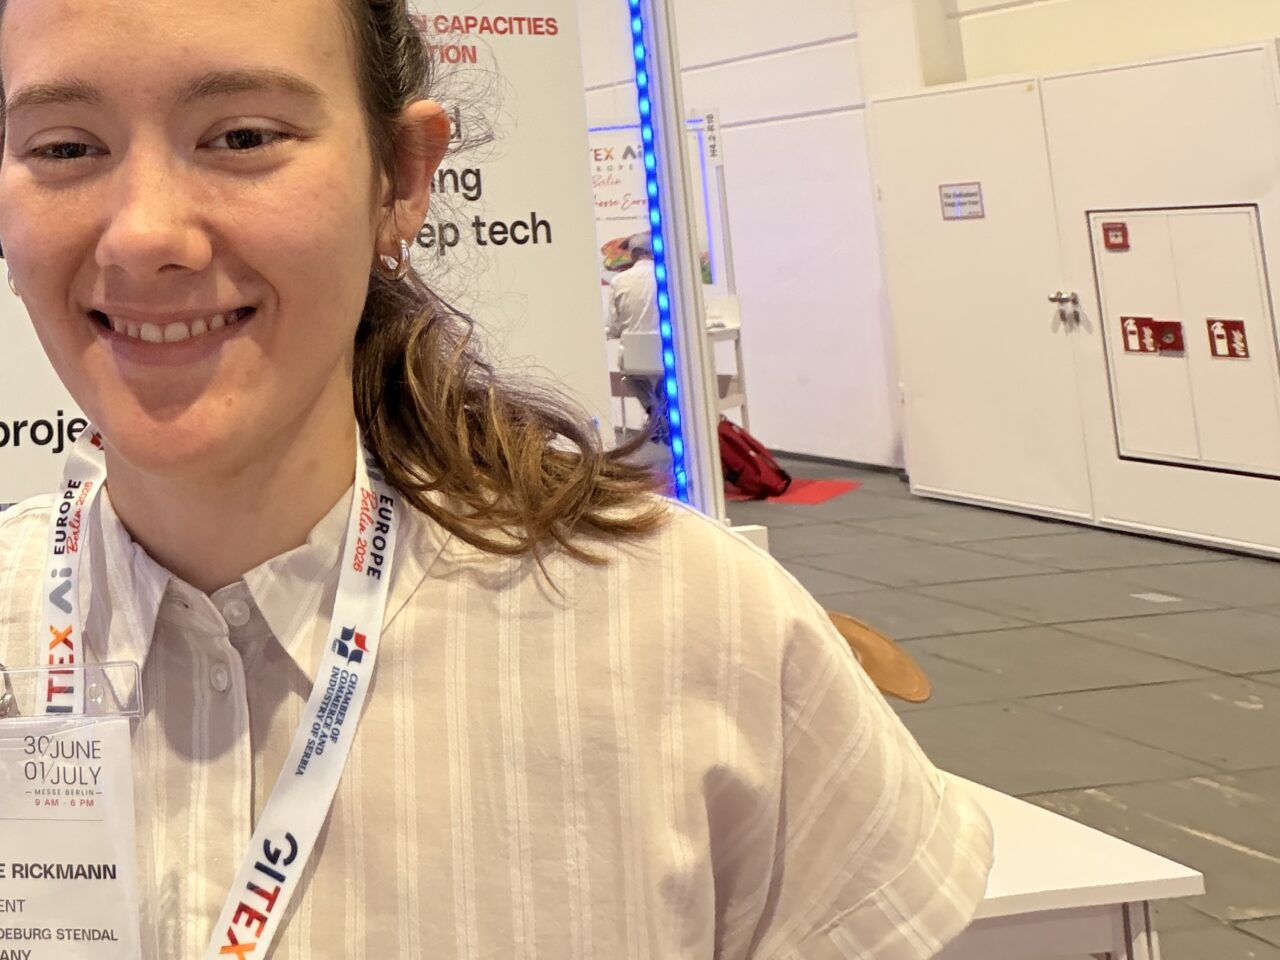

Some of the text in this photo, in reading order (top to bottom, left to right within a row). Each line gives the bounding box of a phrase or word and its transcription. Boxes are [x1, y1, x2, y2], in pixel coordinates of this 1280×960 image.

[433, 15, 559, 36] CAPACITIES
[472, 212, 553, 247] tech
[53, 478, 82, 556] EUROPE
[66, 480, 94, 556] Berlin 2026
[359, 487, 379, 535] Berlin
[352, 537, 368, 573] 2026
[366, 494, 394, 580] EUROPE
[294, 666, 340, 776] INDUSTRY OF SERBIA
[314, 669, 349, 756] COMMERCE AND
[329, 673, 358, 744] CHAMBER OF
[34, 788, 61, 796] MESSE
[44, 799, 59, 807] AM
[80, 799, 94, 807] PM
[12, 863, 117, 880] RICKMANN
[219, 832, 298, 960] GITEX
[56, 928, 119, 941] STENDAL
